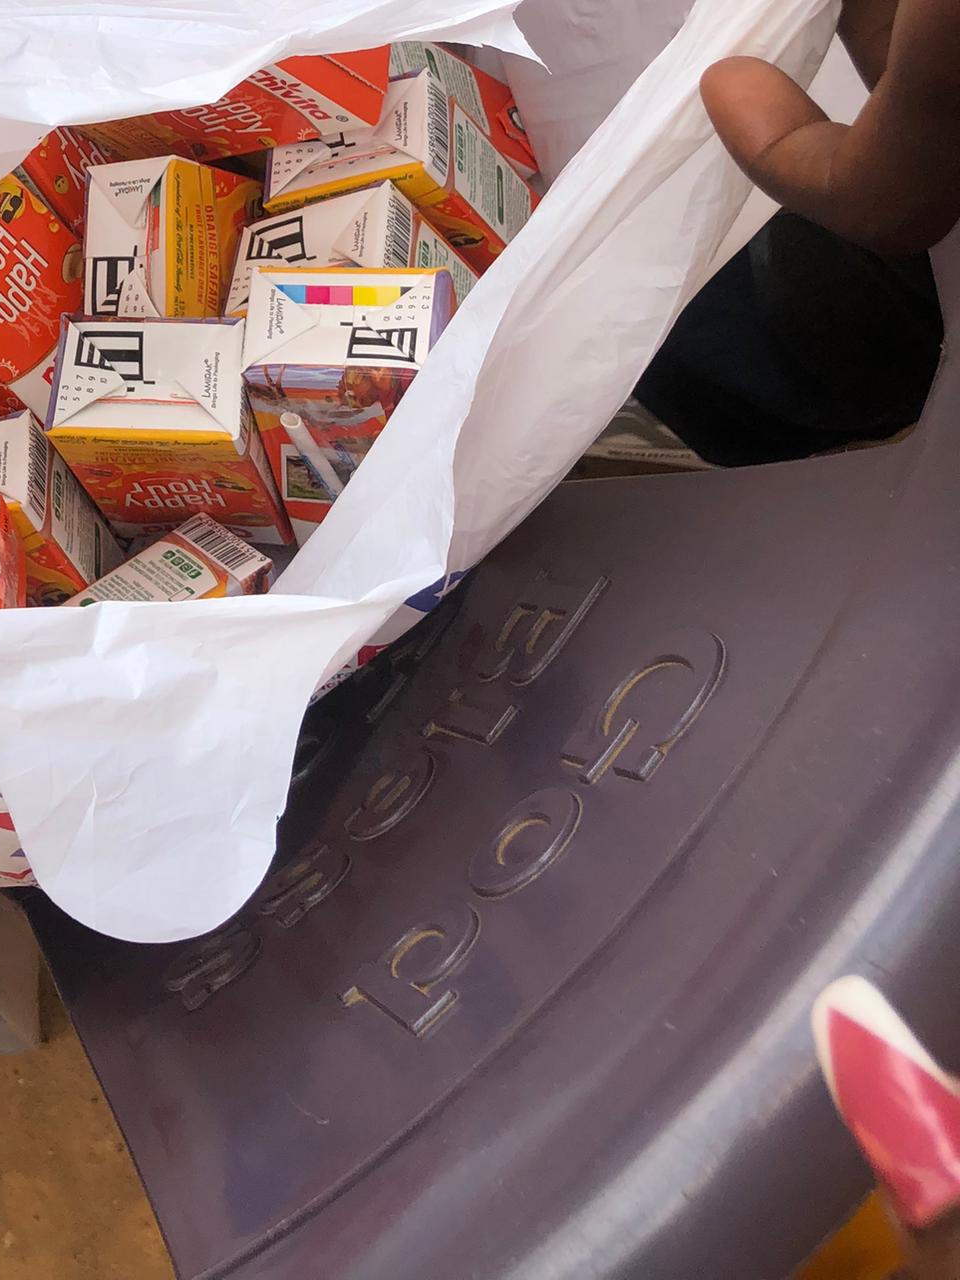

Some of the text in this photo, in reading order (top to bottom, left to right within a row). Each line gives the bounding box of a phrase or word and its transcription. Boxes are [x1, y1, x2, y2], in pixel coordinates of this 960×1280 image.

[204, 205, 220, 313] ORANGE SAFARI
[124, 492, 228, 511] Happy
[129, 478, 212, 495] Hour
[166, 572, 613, 1010] Bless
[339, 630, 728, 1040] God
